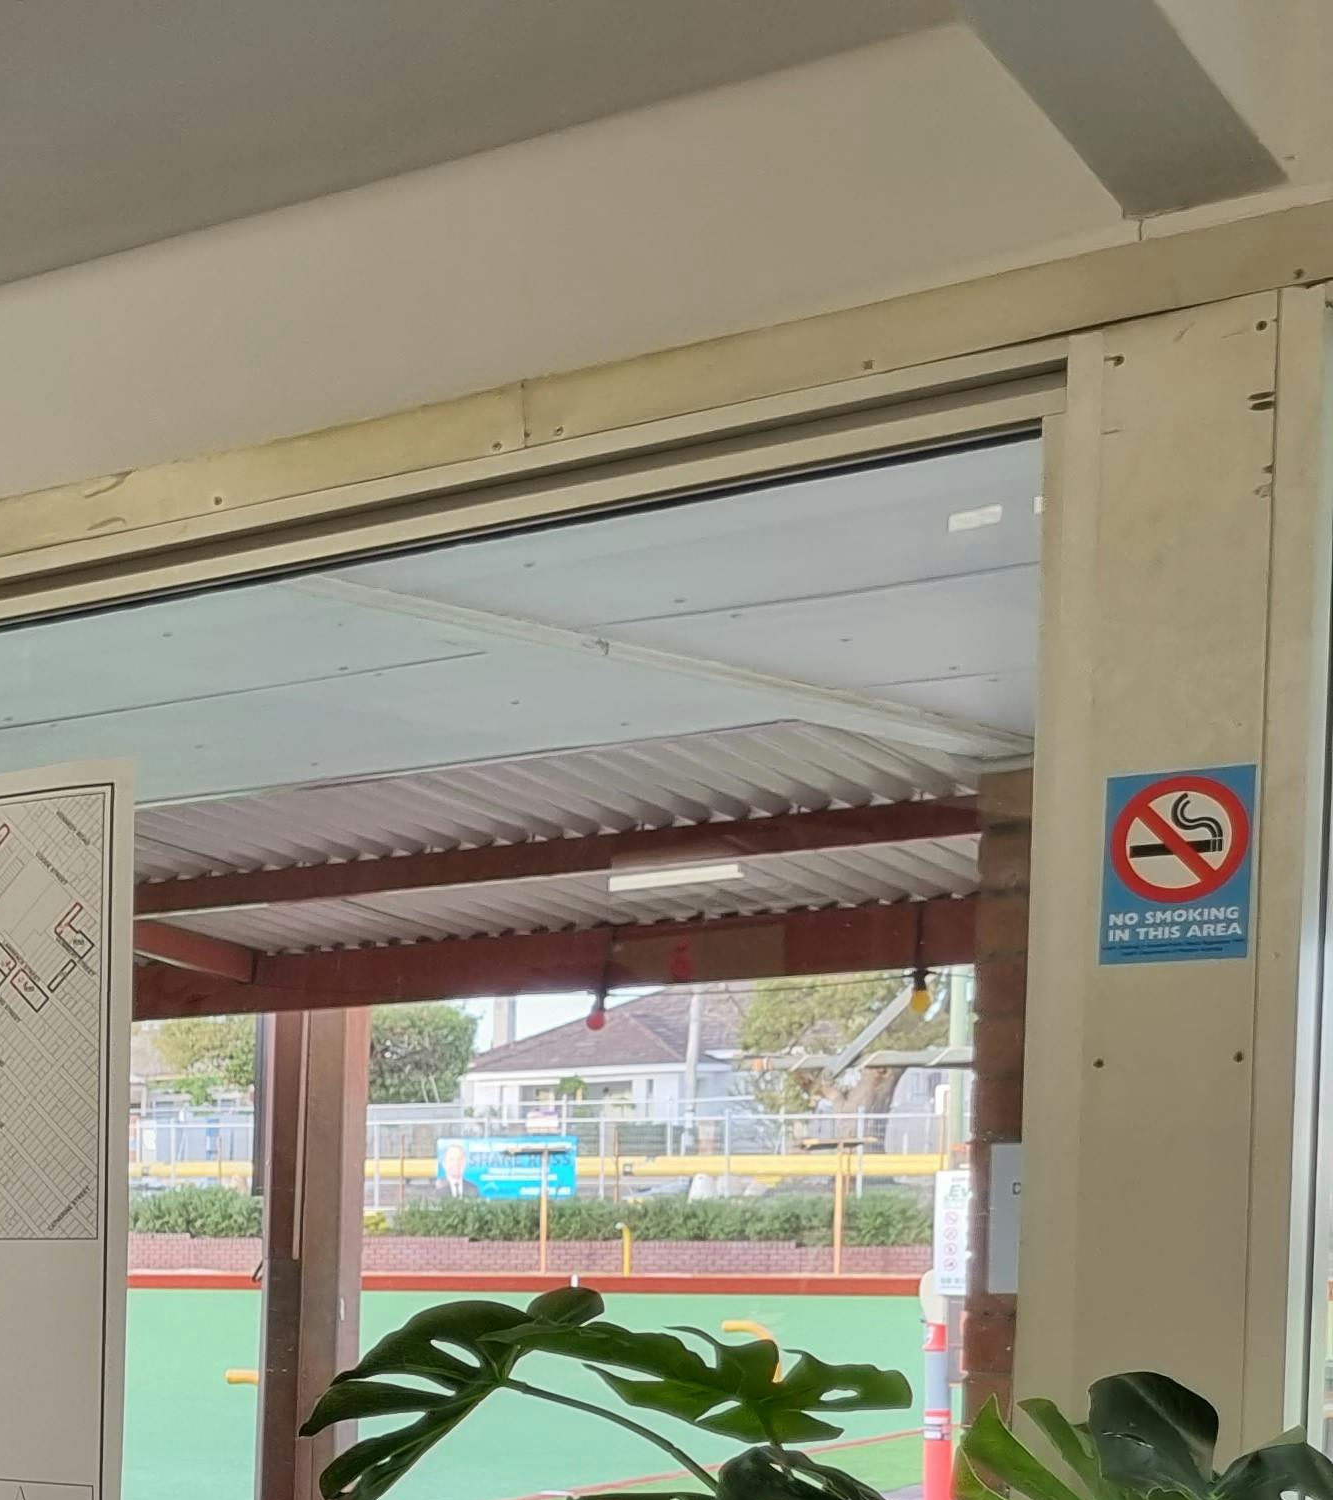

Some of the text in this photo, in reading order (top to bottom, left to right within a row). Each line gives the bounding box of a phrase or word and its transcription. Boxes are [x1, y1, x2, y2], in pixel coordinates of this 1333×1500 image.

[1109, 906, 1240, 926] NO SMOKING
[1108, 922, 1242, 942] IN THIS AREA
